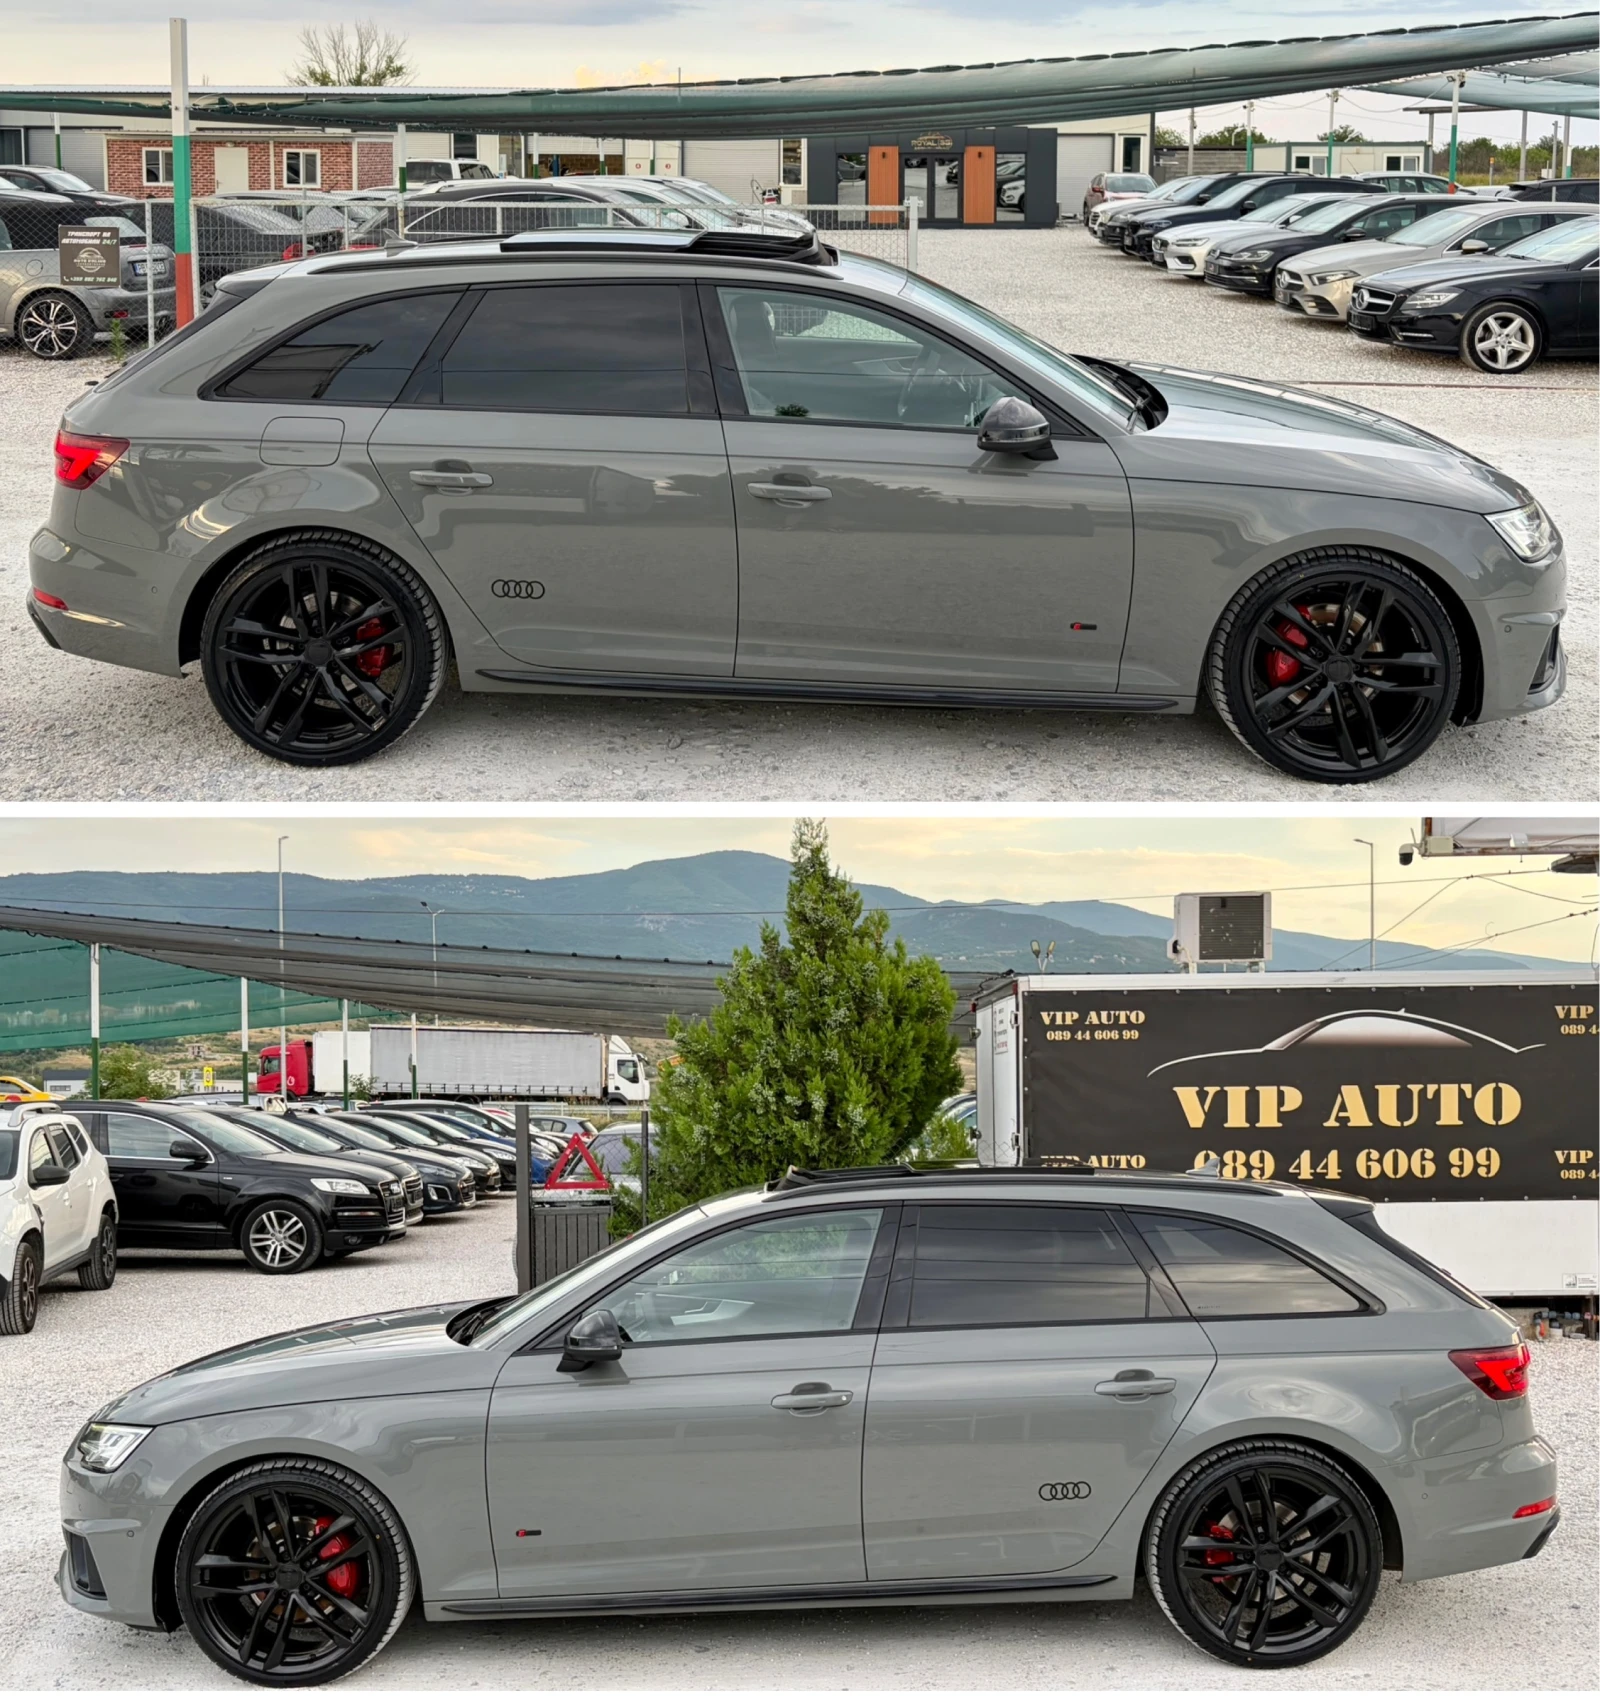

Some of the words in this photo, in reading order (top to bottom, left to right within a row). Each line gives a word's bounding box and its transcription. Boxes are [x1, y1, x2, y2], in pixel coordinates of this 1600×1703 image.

[1040, 1011, 1080, 1025] VIP
[1084, 1010, 1146, 1025] AUTO
[1554, 1005, 1594, 1019] VIP
[1046, 1030, 1072, 1041] 089
[1074, 1030, 1091, 1041] 44
[1094, 1029, 1120, 1040] 606
[1122, 1029, 1140, 1040] 99
[1560, 1024, 1586, 1035] 089
[1588, 1024, 1599, 1035] 4
[1172, 1085, 1303, 1128] VIP
[1322, 1082, 1522, 1127] AUTO
[1087, 1154, 1146, 1169] AUTO
[1288, 1149, 1342, 1180] 44
[1355, 1147, 1437, 1179] 606
[1448, 1147, 1501, 1178] 99
[1554, 1150, 1594, 1164] VIP
[1560, 1169, 1586, 1180] 089
[1588, 1169, 1599, 1180] 4
